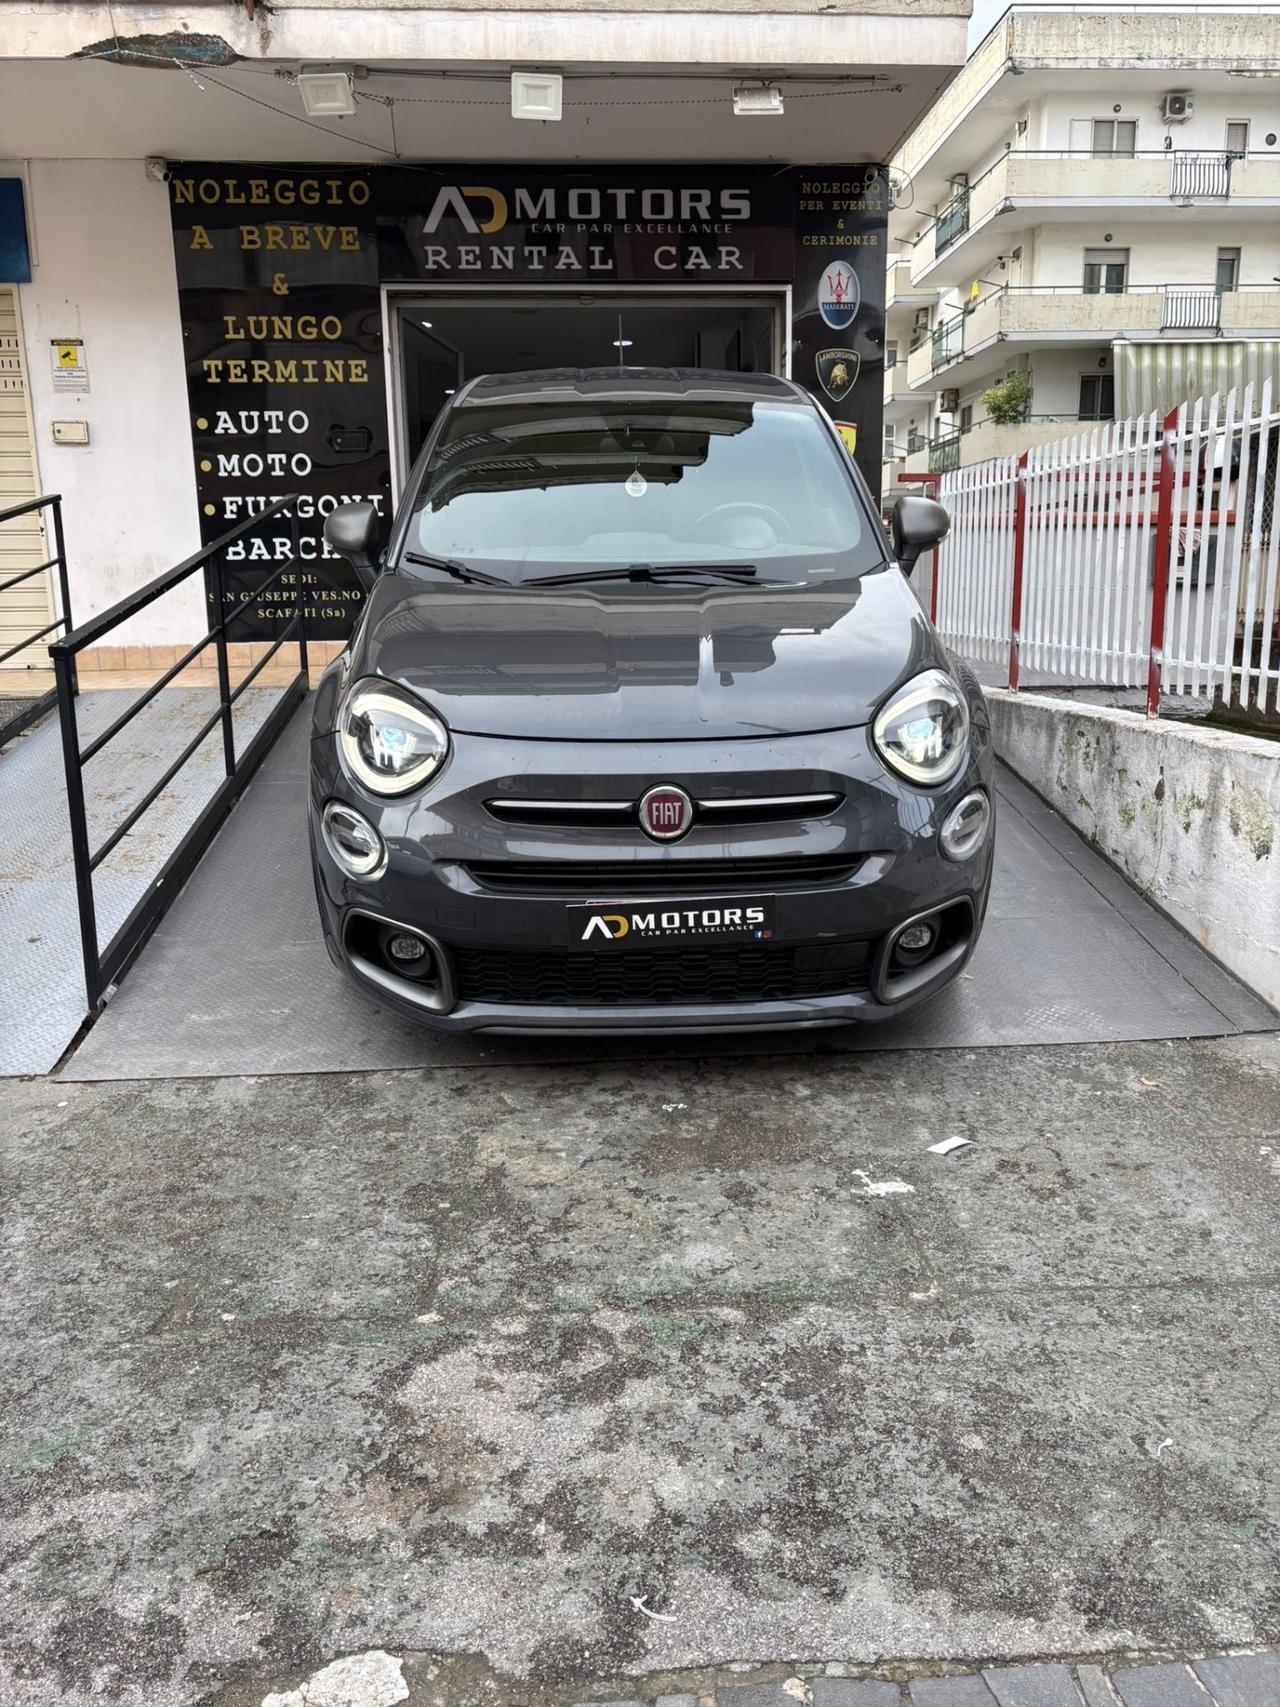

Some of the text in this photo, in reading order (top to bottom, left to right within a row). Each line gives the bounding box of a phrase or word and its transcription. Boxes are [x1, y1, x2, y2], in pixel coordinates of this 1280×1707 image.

[173, 179, 371, 205] NOLEGGIO
[801, 182, 881, 194] NOLEGGIO
[515, 188, 750, 220] MOTORS
[799, 200, 883, 211] PER EVENTI
[531, 223, 733, 234] CAR PAR EXCELLANCE
[836, 218, 845, 229] &
[190, 225, 360, 250] A BREVE
[802, 235, 878, 246] CERIMONIE
[424, 246, 744, 270] RENTAL CAR
[272, 272, 289, 295] &
[223, 315, 342, 340] LUNGO
[203, 360, 368, 383] TERMINE
[214, 410, 310, 434] AUTO
[217, 453, 312, 477] MOTO
[208, 592, 235, 603] SN
[312, 590, 361, 601] VES.NO
[321, 608, 346, 619] (Sa)
[651, 802, 682, 825] FIAT
[632, 906, 765, 930] MOTORS
[691, 924, 755, 934] EXCELLANCE
